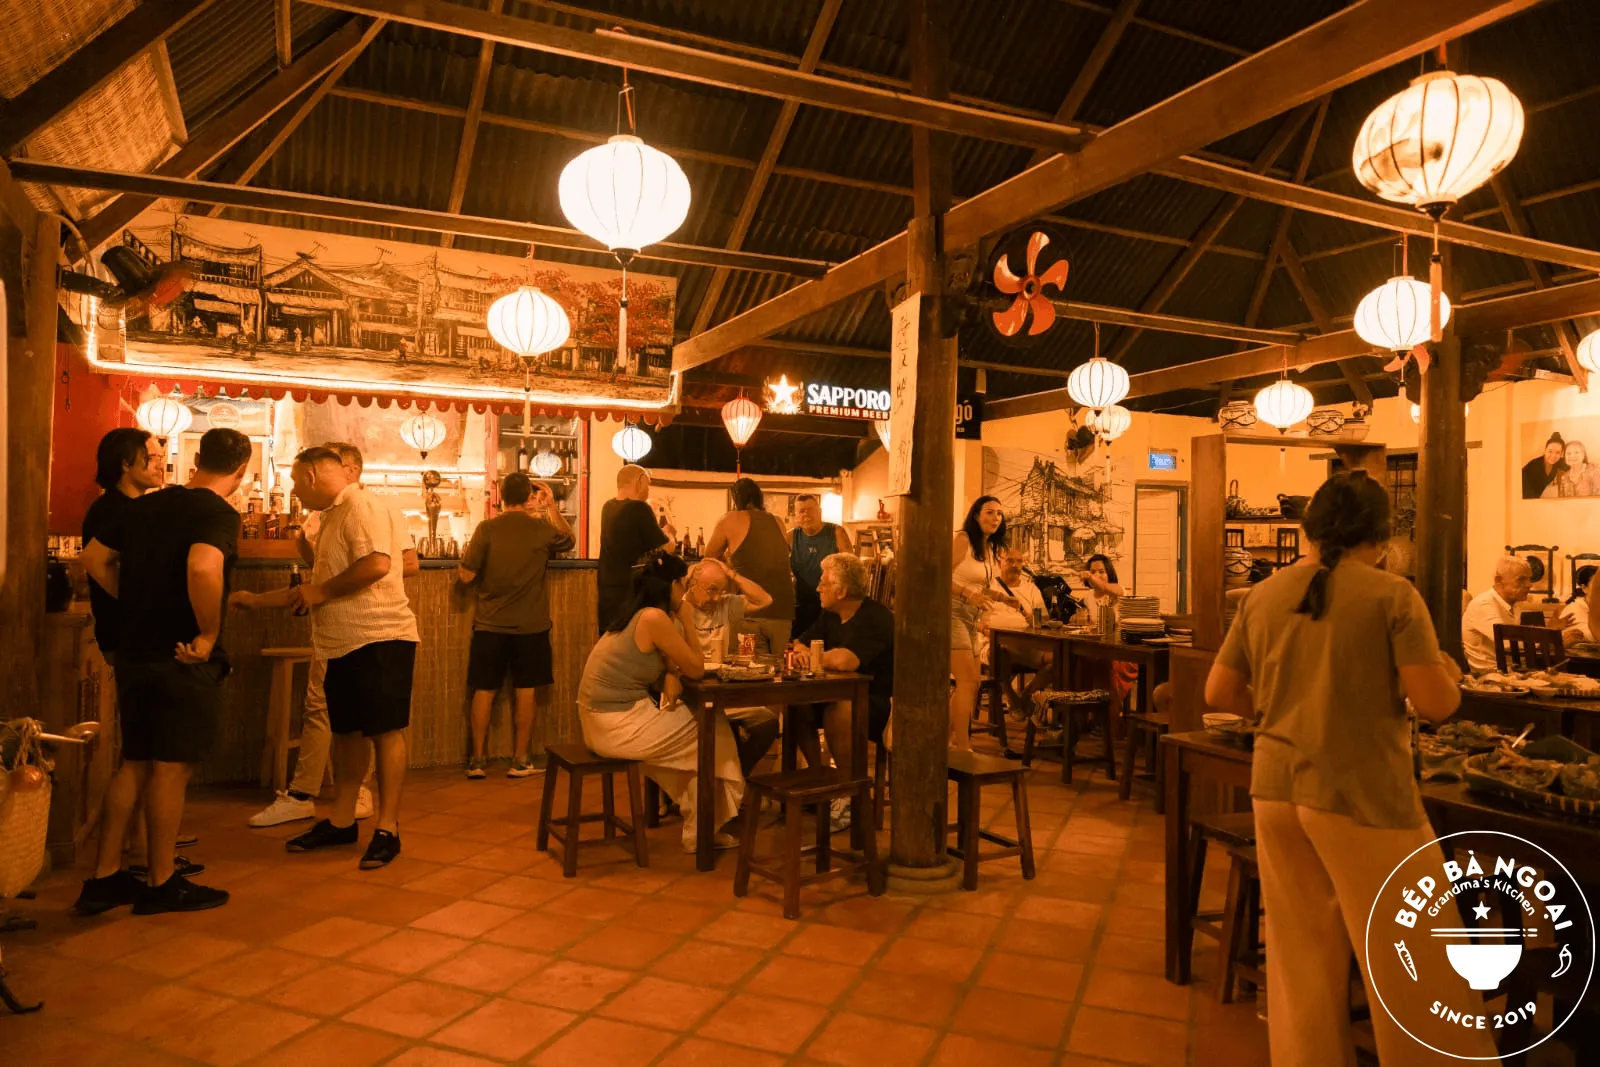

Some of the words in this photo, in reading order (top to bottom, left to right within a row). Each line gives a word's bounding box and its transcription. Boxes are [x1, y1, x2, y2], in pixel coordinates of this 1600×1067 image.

[807, 383, 891, 411] SAPPORO
[809, 405, 860, 417] PREMIUM
[862, 409, 889, 420] BEER
